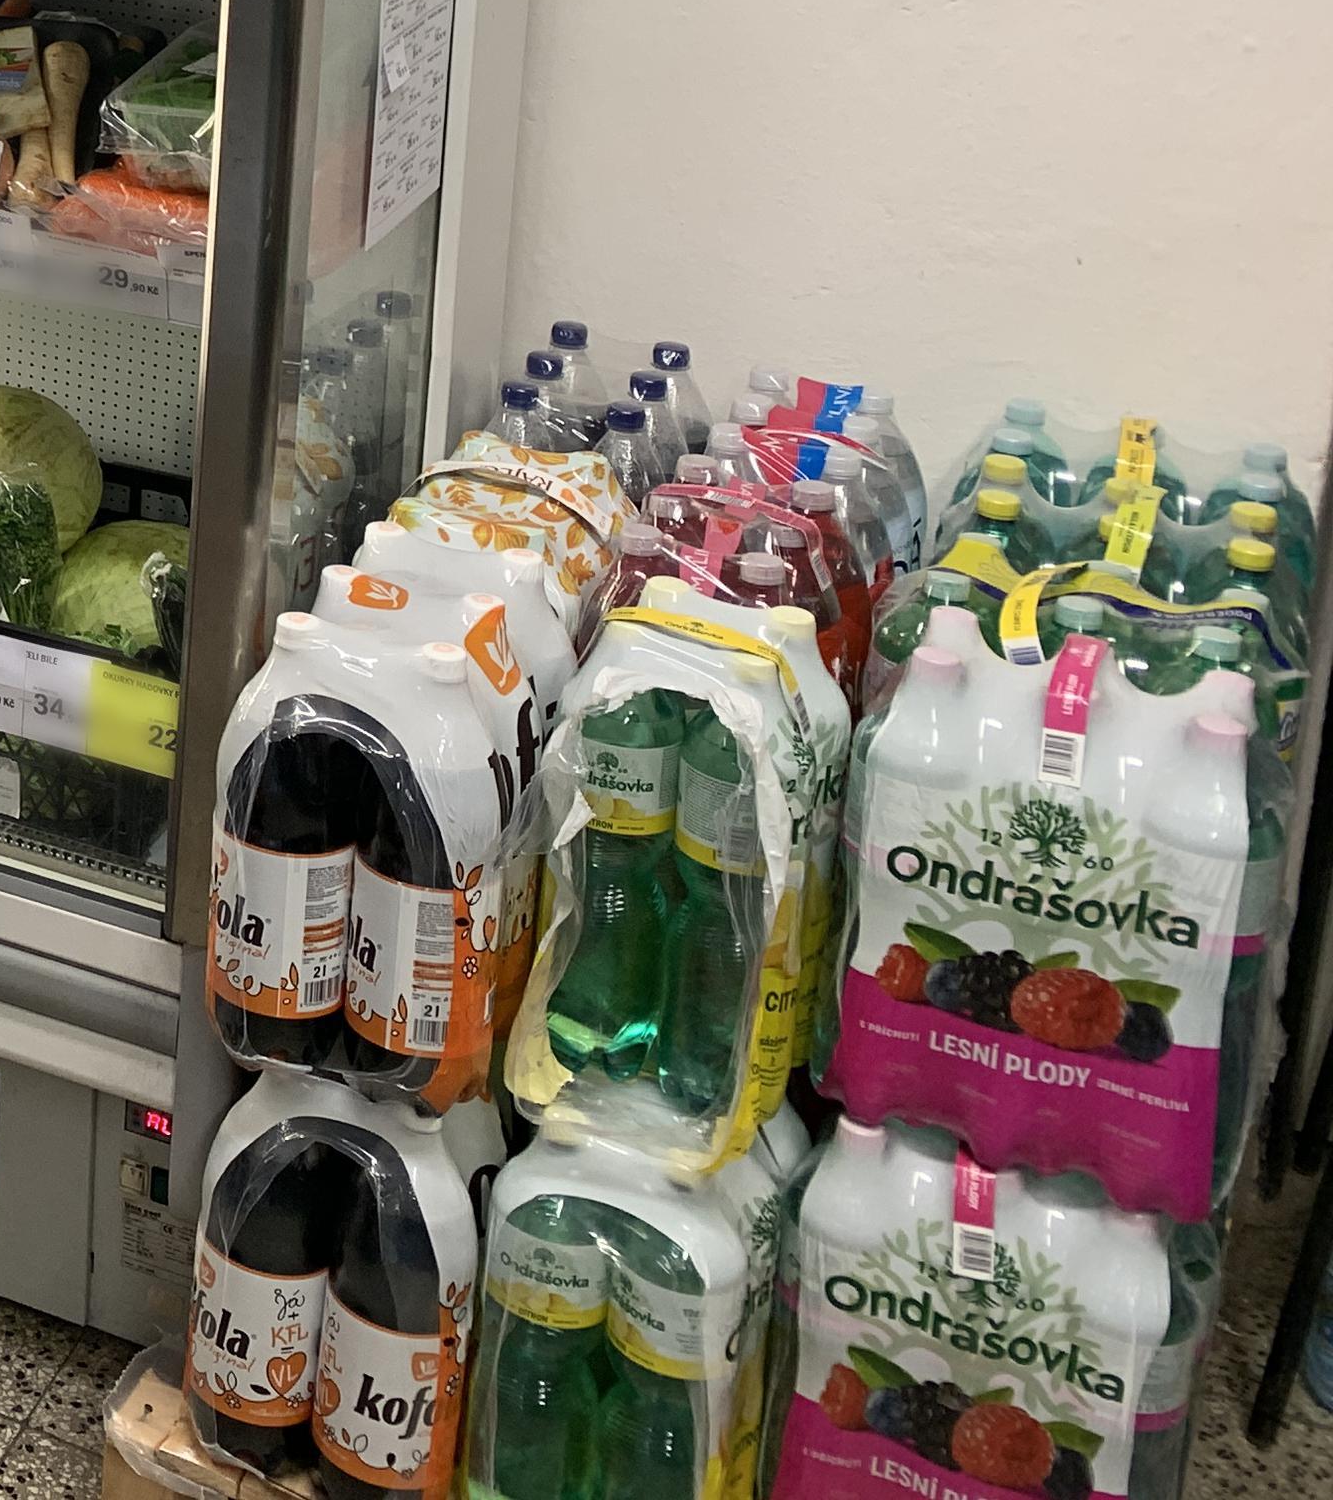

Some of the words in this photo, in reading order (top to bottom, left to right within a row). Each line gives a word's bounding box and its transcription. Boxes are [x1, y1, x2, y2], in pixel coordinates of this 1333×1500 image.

[3, 697, 15, 709] Kč
[981, 827, 1003, 847] 12
[1083, 854, 1113, 872] 60
[885, 845, 1200, 949] Ondrášovka
[928, 1030, 999, 1070] LESNÍ
[1004, 1051, 1092, 1089] PLODY
[274, 1288, 305, 1320] Já
[271, 1325, 308, 1348] KFL
[824, 1273, 1125, 1404] Ondrášovka
[272, 1365, 299, 1387] VL
[870, 1455, 938, 1500] LESNÍ
